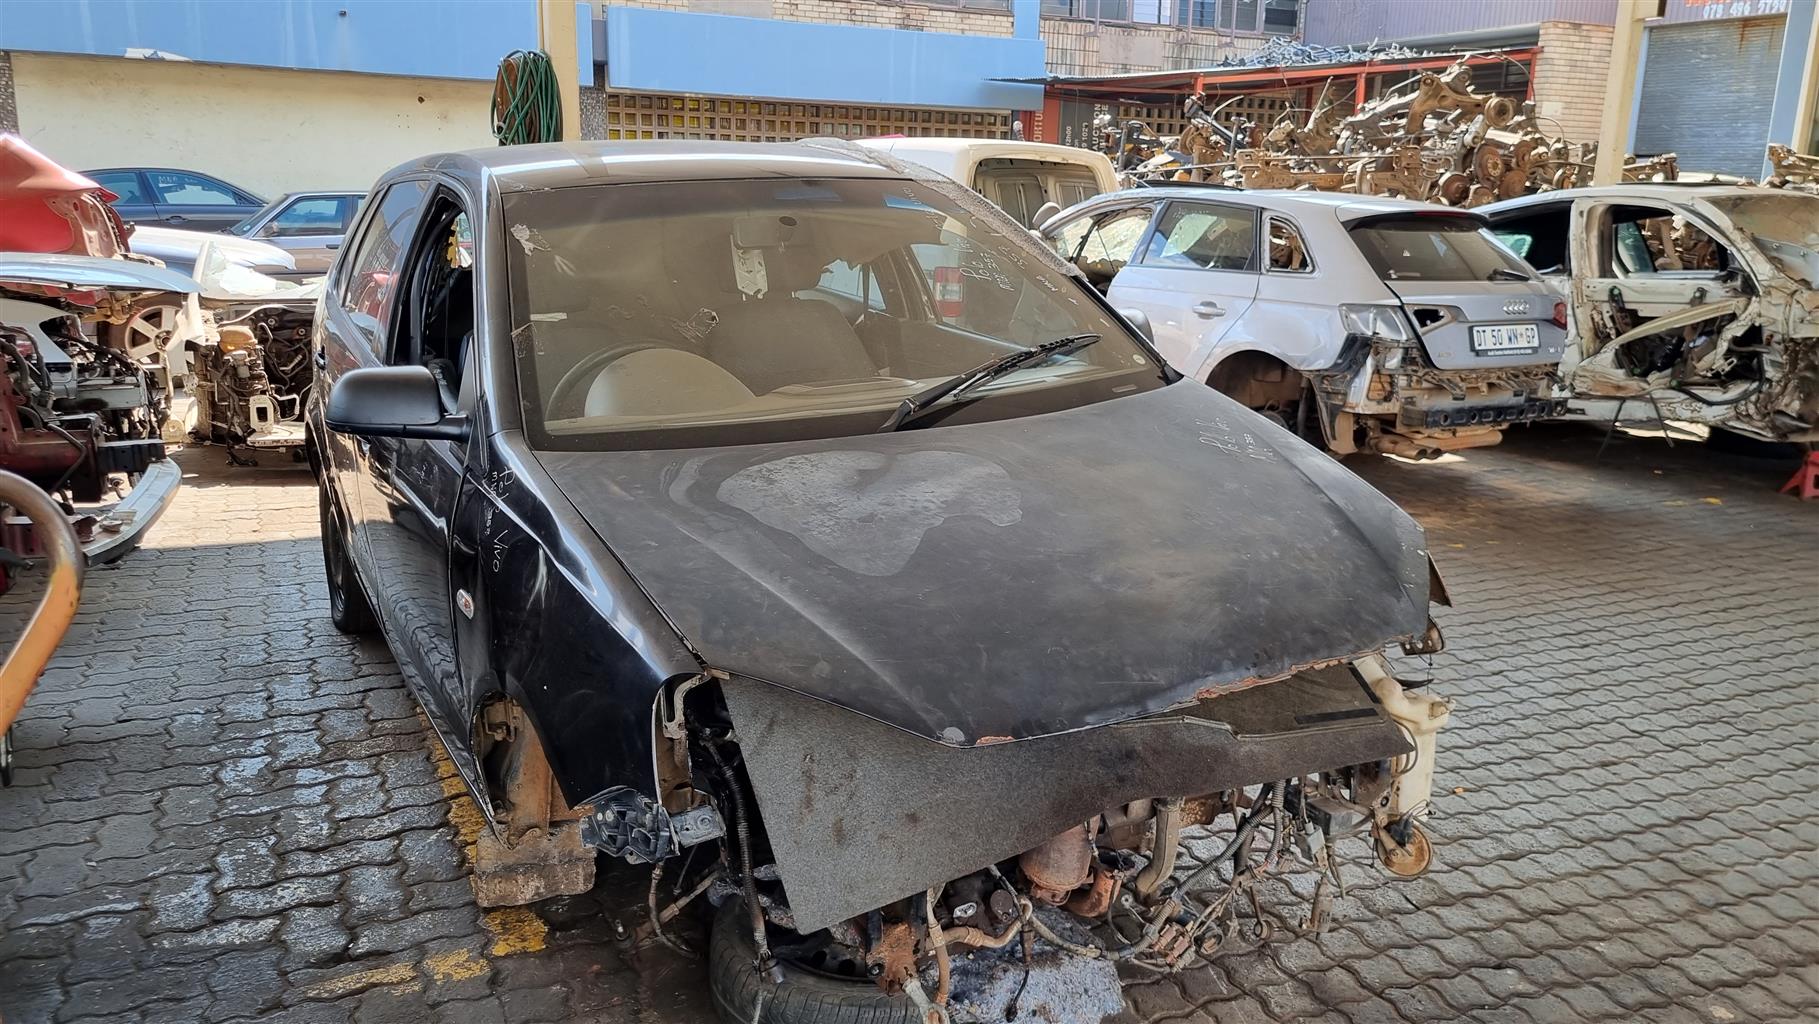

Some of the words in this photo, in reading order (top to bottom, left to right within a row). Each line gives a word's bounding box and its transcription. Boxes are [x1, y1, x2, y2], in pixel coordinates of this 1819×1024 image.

[1092, 103, 1101, 151] AUCTON
[1476, 329, 1486, 347] DT
[1491, 329, 1503, 346] 50
[1506, 327, 1518, 345] WN
[1525, 327, 1535, 344] GP
[493, 530, 509, 572] Vivo
